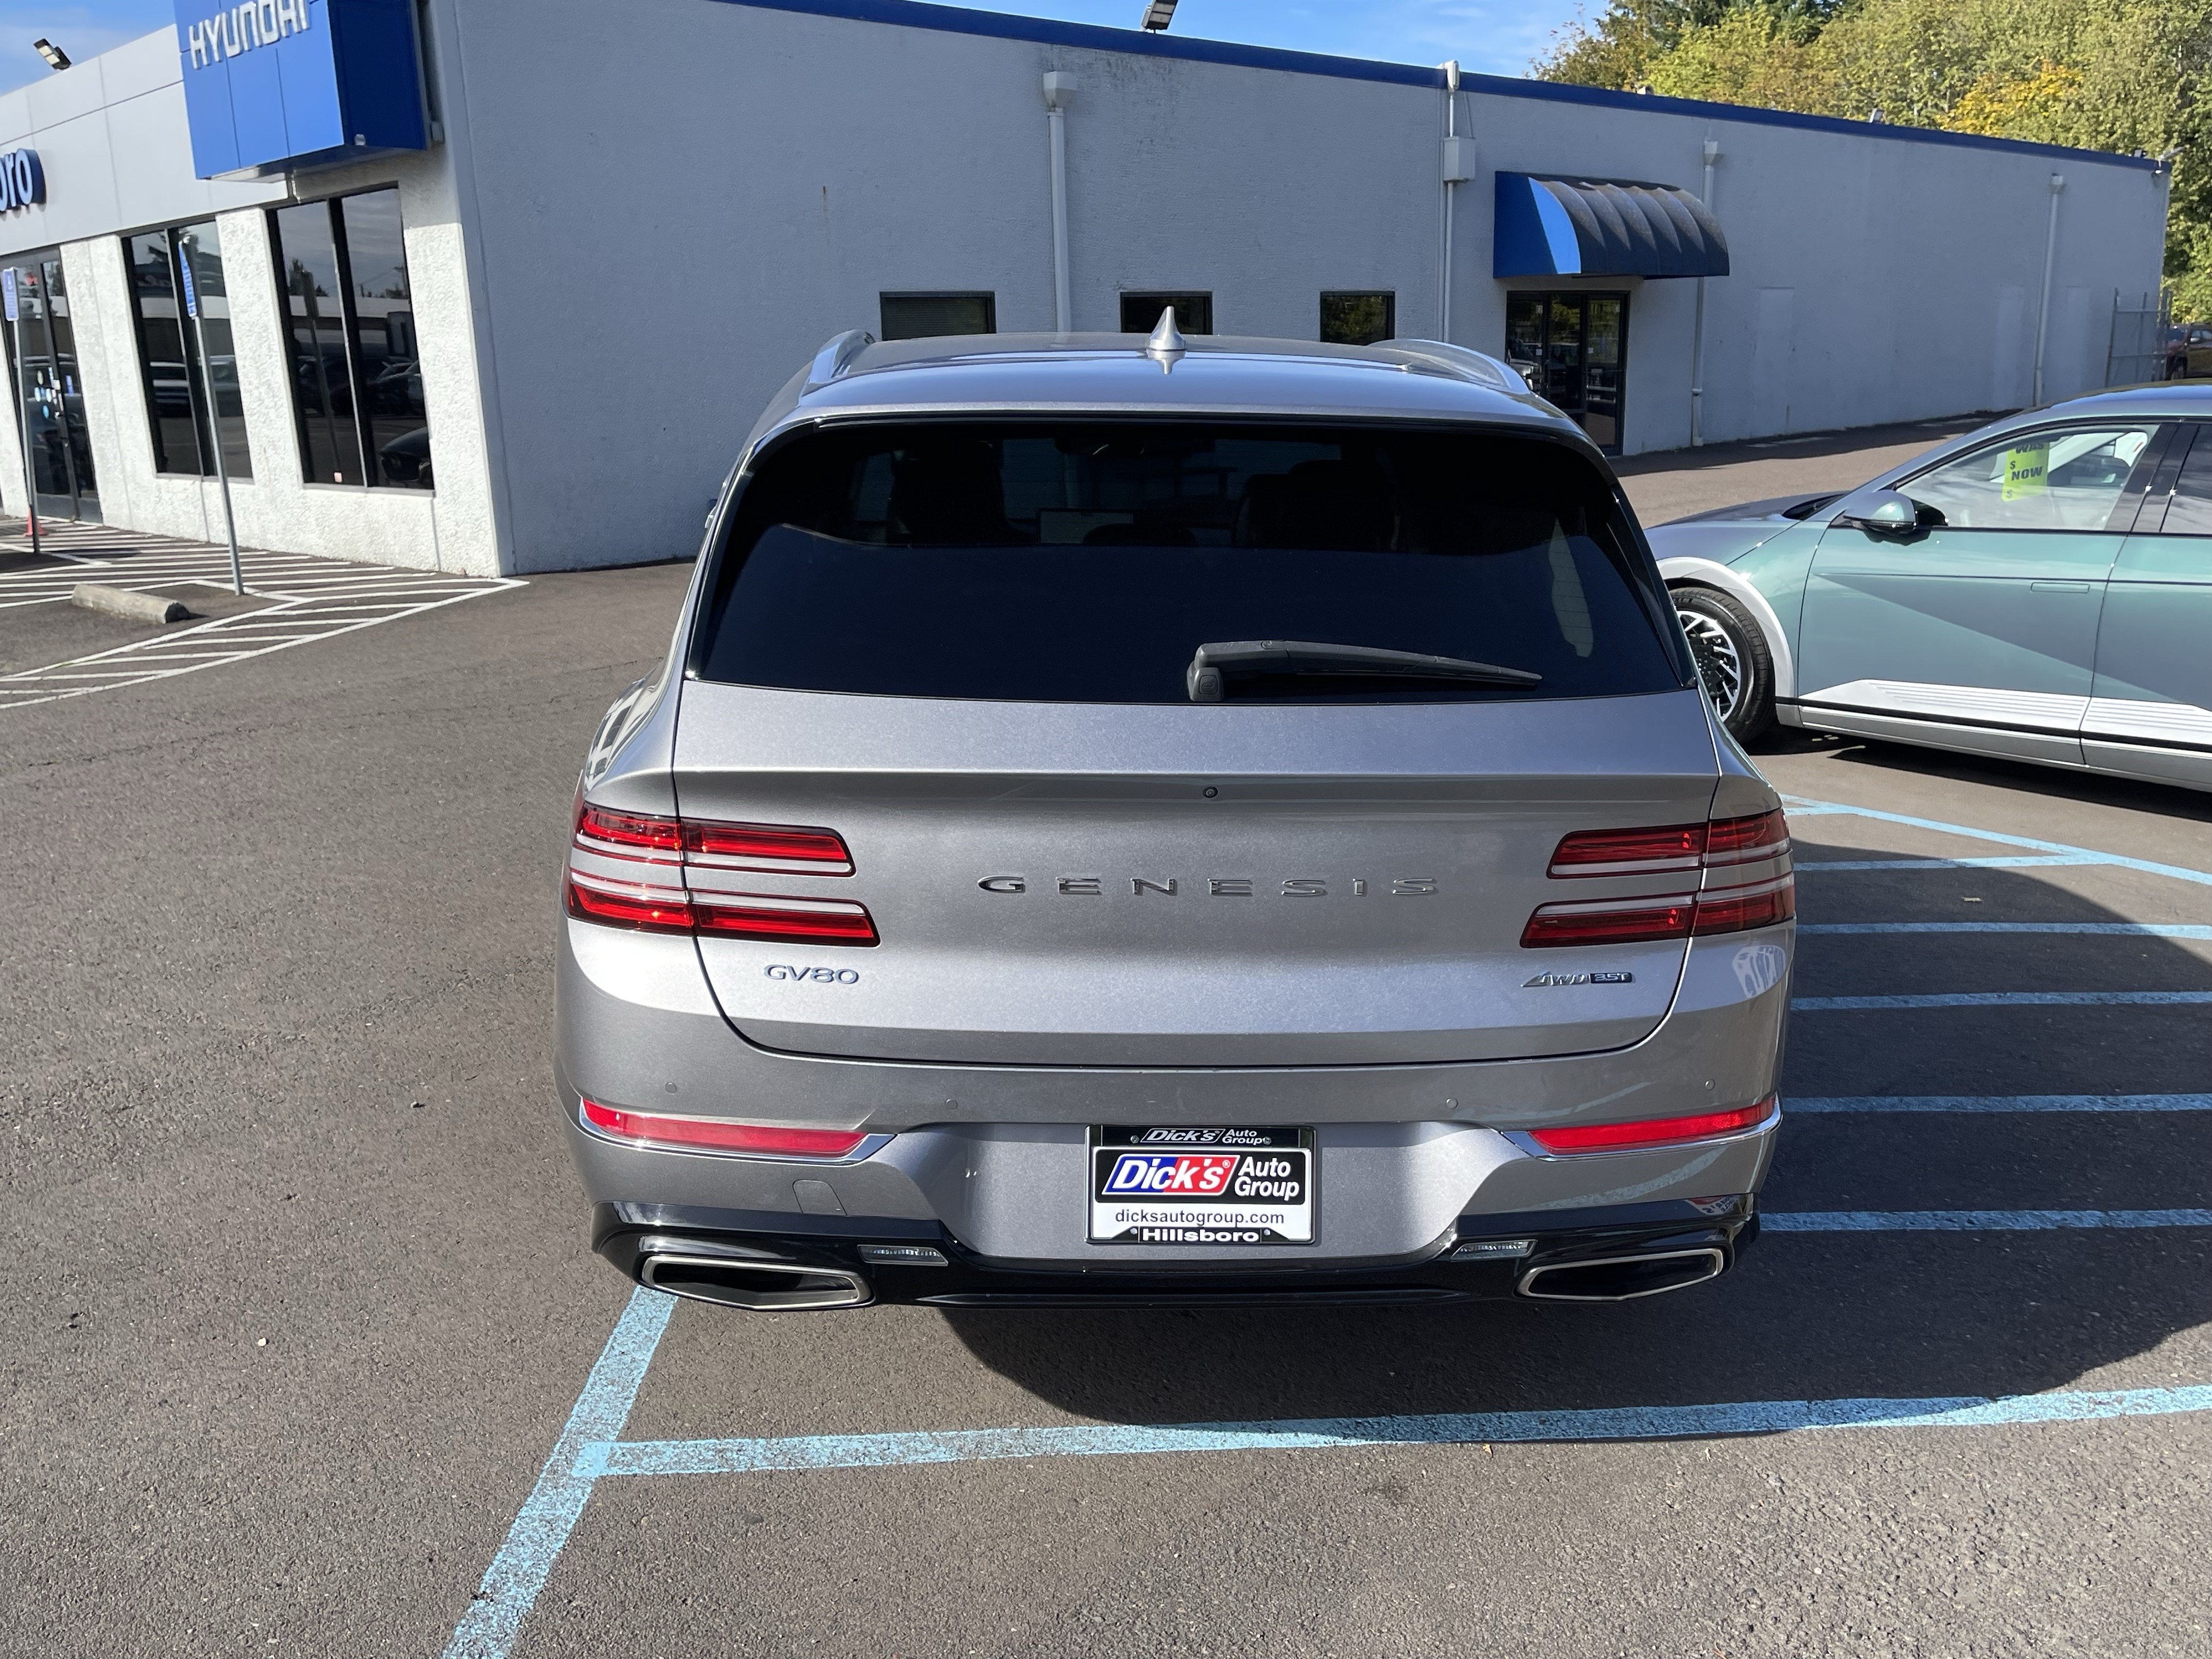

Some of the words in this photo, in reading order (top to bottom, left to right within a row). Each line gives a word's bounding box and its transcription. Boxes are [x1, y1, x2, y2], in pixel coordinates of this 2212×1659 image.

[189, 0, 311, 70] HYUNDAI
[2011, 466, 2042, 481] NOW
[977, 876, 1434, 895] GENESIS
[764, 964, 860, 985] GV80
[1520, 972, 1587, 988] AWD
[1146, 1130, 1217, 1141] Dick's
[1222, 1136, 1264, 1146] Group
[1112, 1159, 1224, 1190] Dick's
[1238, 1156, 1291, 1178] Auto
[1234, 1176, 1299, 1201] Group
[1115, 1209, 1284, 1227] dicksautogroup.com
[1142, 1228, 1260, 1242] Hillsboro
